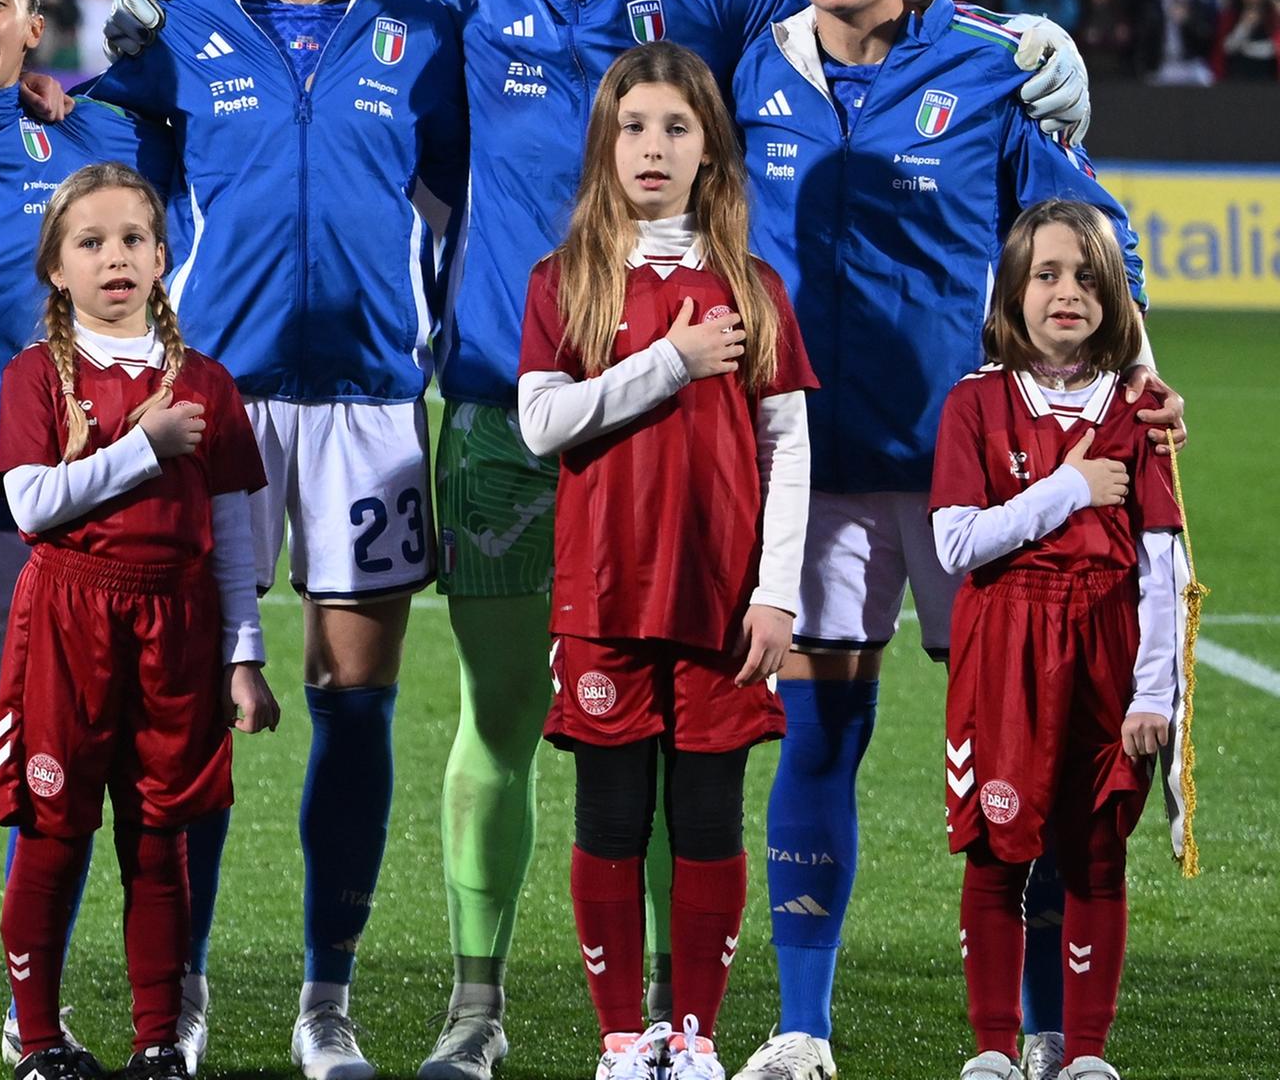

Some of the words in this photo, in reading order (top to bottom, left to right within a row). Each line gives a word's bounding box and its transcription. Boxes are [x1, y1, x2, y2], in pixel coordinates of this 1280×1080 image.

[632, 2, 659, 15] ITALIA
[378, 21, 403, 34] ITALIA
[225, 77, 254, 92] TIM
[366, 78, 398, 95] Telepass
[504, 79, 547, 95] Poste
[214, 95, 258, 113] Poste
[354, 98, 377, 114] eni
[926, 93, 952, 107] ITALIA
[776, 144, 798, 159] TIM
[901, 154, 941, 167] Telepass
[766, 162, 795, 178] Poste
[892, 176, 917, 191] eni
[24, 201, 46, 215] eni
[350, 487, 426, 574] 23
[583, 685, 608, 700] DBU
[767, 846, 835, 865] ITALIA
